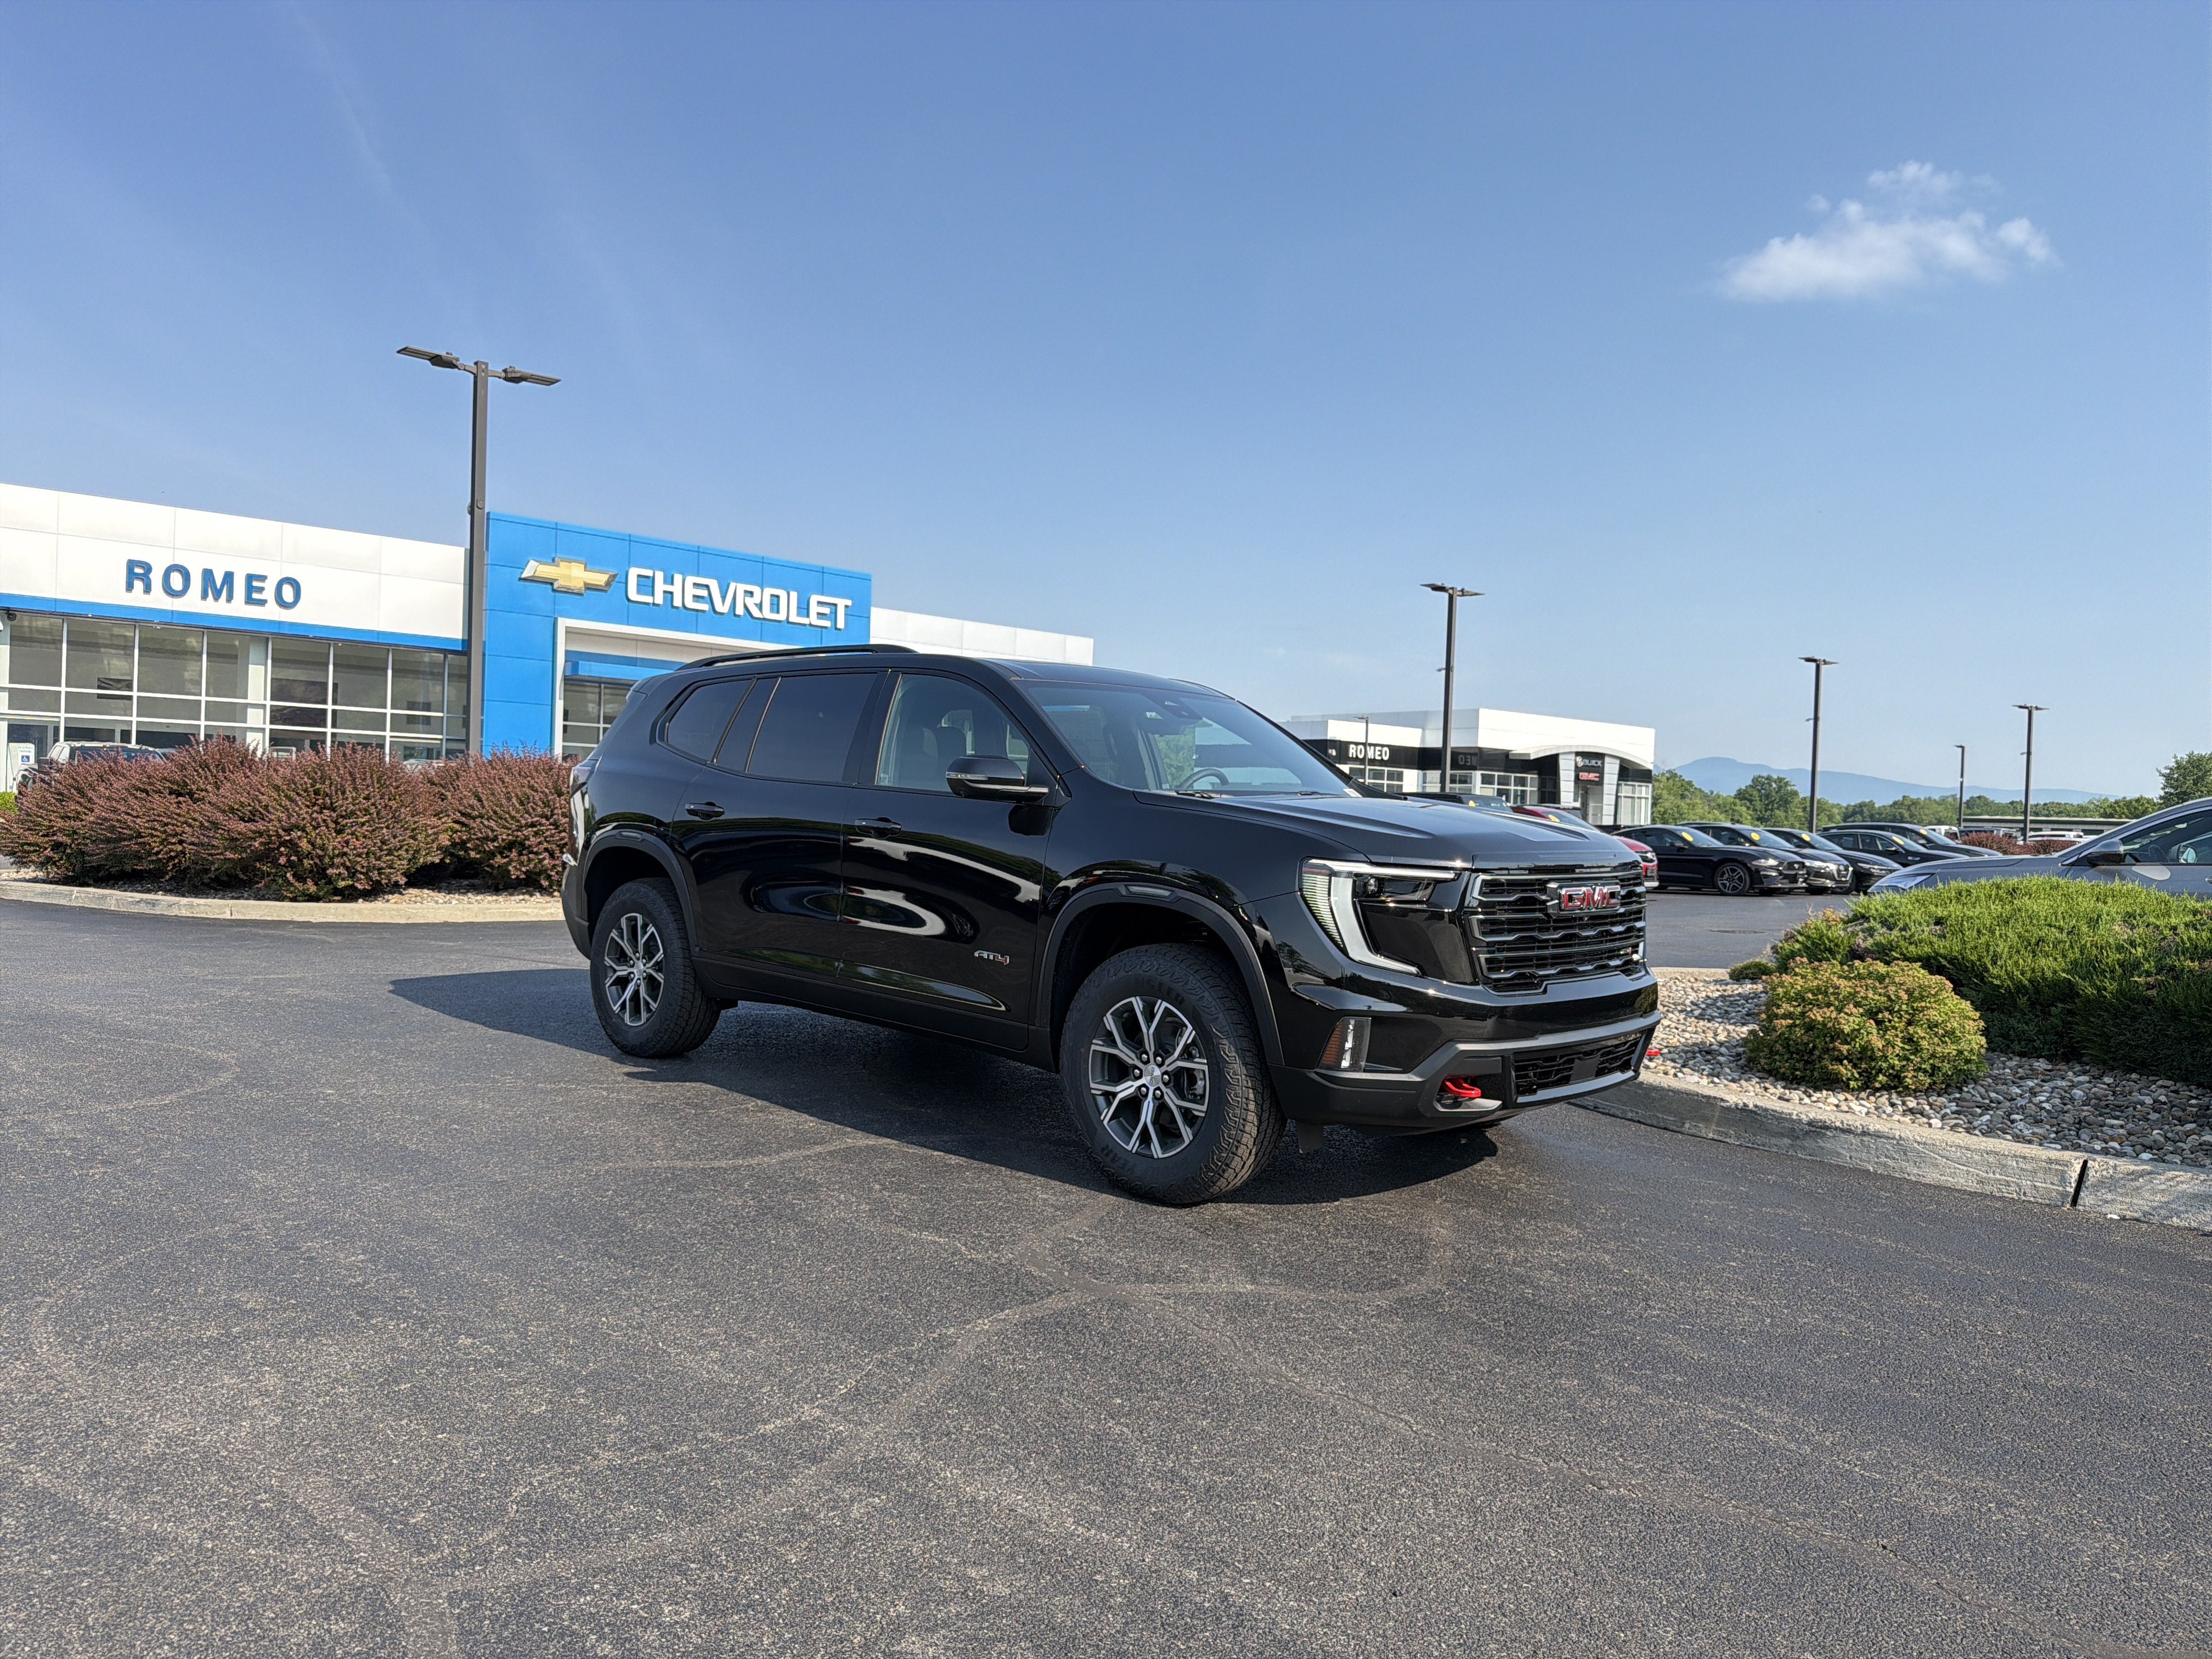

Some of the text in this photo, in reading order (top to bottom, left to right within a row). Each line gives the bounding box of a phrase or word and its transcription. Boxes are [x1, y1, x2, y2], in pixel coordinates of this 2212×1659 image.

[125, 558, 301, 610] ROMEO
[627, 566, 852, 630] CHEVROLET
[1348, 744, 1390, 761] ROMEO
[1582, 759, 1602, 767] BUICK
[1579, 772, 1600, 781] GMC
[1562, 885, 1621, 909] GMC
[974, 950, 1009, 966] AT4
